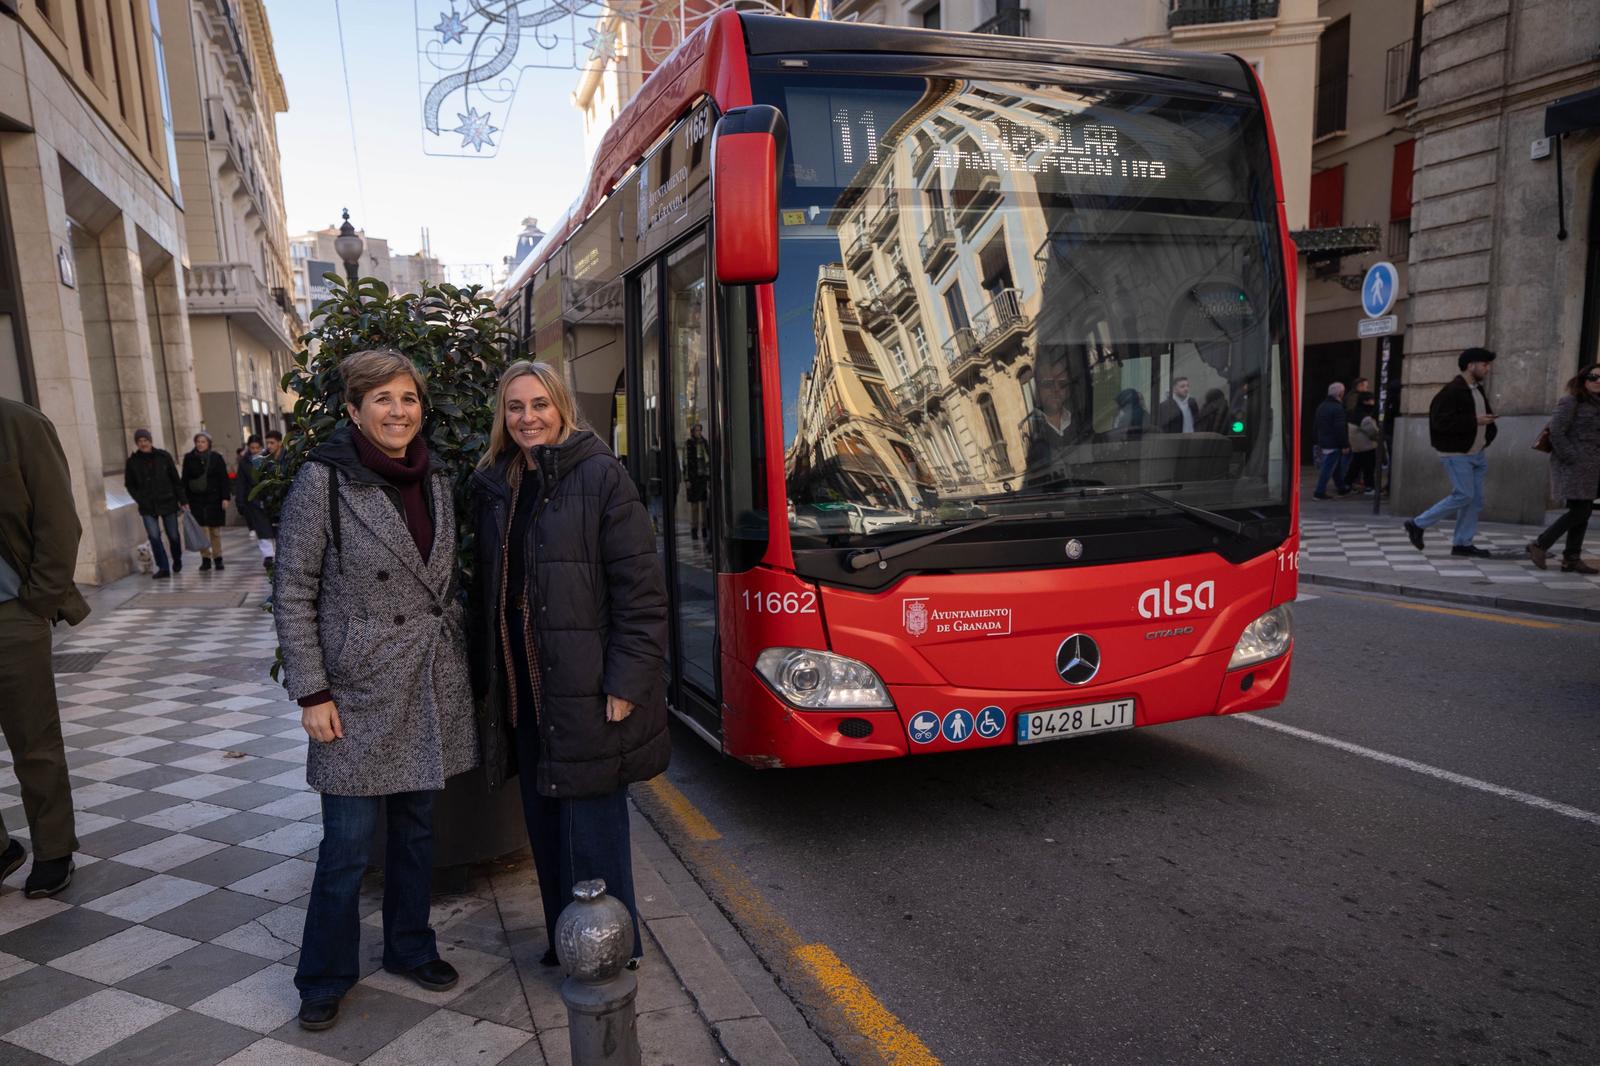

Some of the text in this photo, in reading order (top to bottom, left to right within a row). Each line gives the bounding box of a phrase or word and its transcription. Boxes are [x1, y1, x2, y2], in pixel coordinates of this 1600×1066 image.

[685, 107, 709, 150] 11662
[833, 109, 878, 164] 11
[981, 118, 1119, 156] CIRCULAR
[742, 589, 816, 614] 11662
[931, 608, 1009, 620] AYUNTAMIENTO
[1138, 580, 1215, 618] alsa
[937, 620, 1002, 632] DE GRANADA
[1146, 626, 1194, 639] CITARO
[1031, 703, 1128, 736] 9428 LJT
